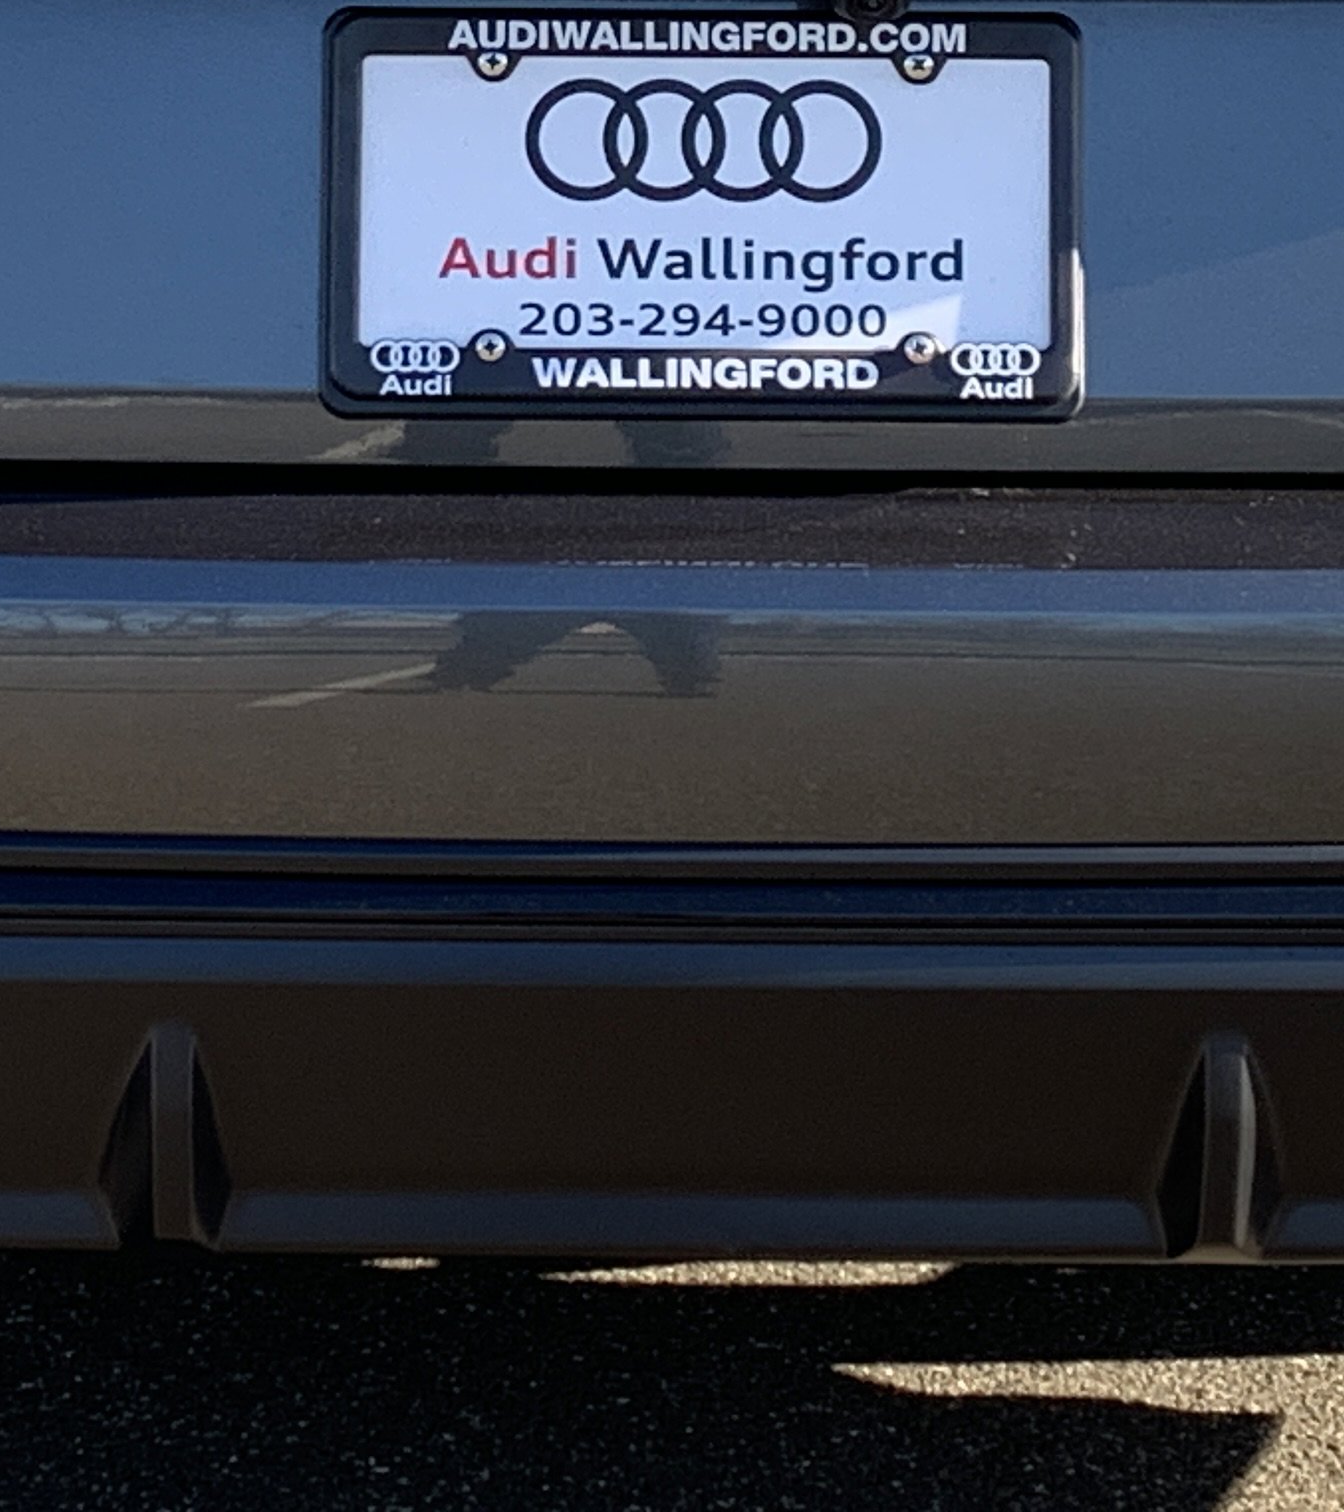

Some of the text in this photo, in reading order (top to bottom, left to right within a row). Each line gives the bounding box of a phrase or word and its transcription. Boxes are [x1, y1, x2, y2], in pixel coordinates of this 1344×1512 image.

[448, 19, 967, 53] AUDIWALLINGFORD.COM
[439, 236, 963, 292] Audi Wallingford
[519, 302, 887, 337] 203-294-9000
[379, 374, 452, 396] Audi
[531, 357, 880, 390] WALLINGFORD
[959, 376, 1033, 400] Audi
